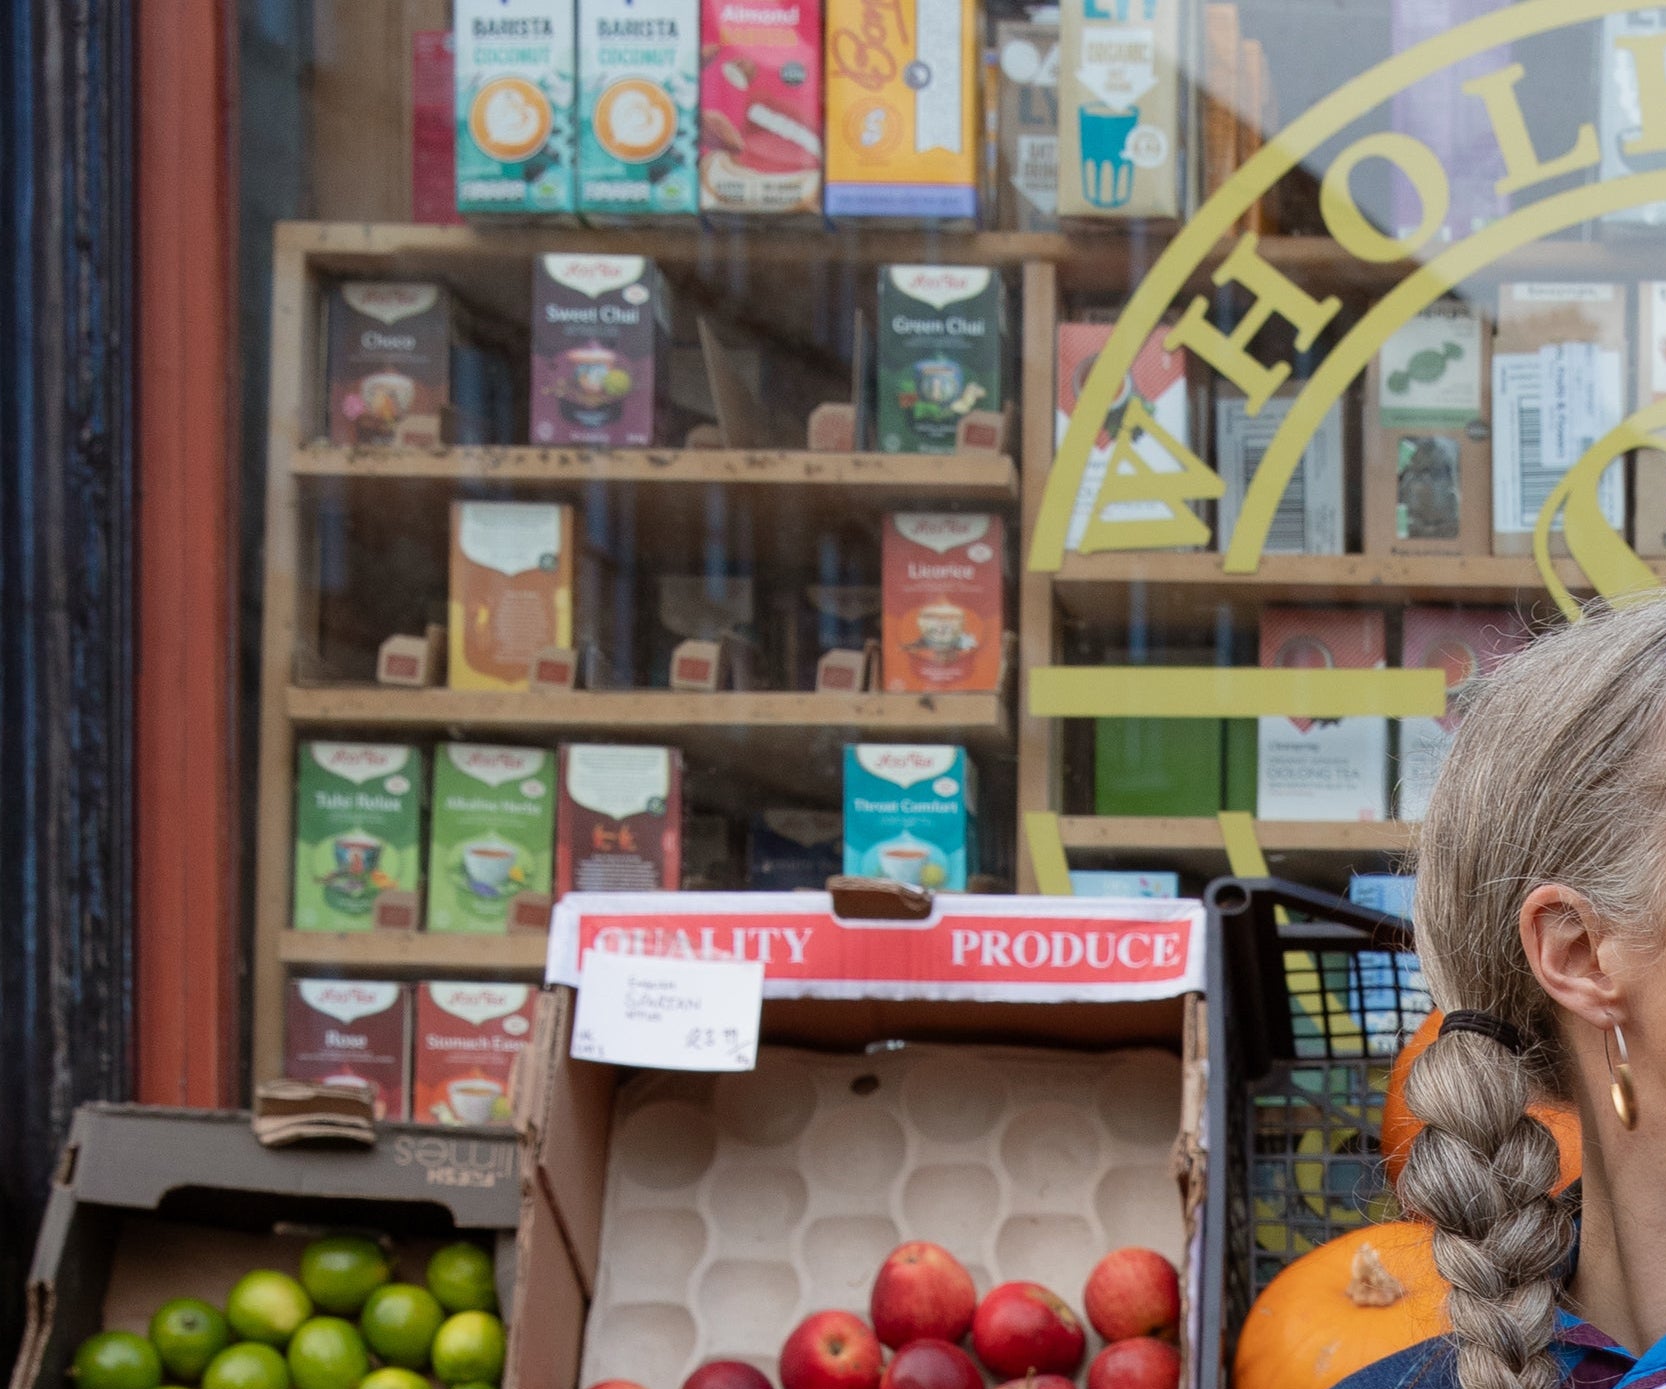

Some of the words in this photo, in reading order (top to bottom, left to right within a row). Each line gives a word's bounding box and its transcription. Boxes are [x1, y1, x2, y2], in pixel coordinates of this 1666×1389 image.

[472, 17, 553, 37] BARISTA
[597, 17, 679, 37] BARISTA
[546, 305, 596, 325] Sweet
[600, 304, 640, 325] Chai
[892, 314, 944, 336] Green
[945, 315, 986, 336] Chai
[908, 562, 976, 581] Licorice
[854, 798, 899, 814] Throat
[901, 799, 959, 815] Comfort
[592, 925, 814, 965] QUALITY
[951, 928, 1182, 969] PRODUCE
[324, 1030, 368, 1050] Rose
[426, 1033, 490, 1050] Stomach
[395, 1135, 514, 1181] limes
